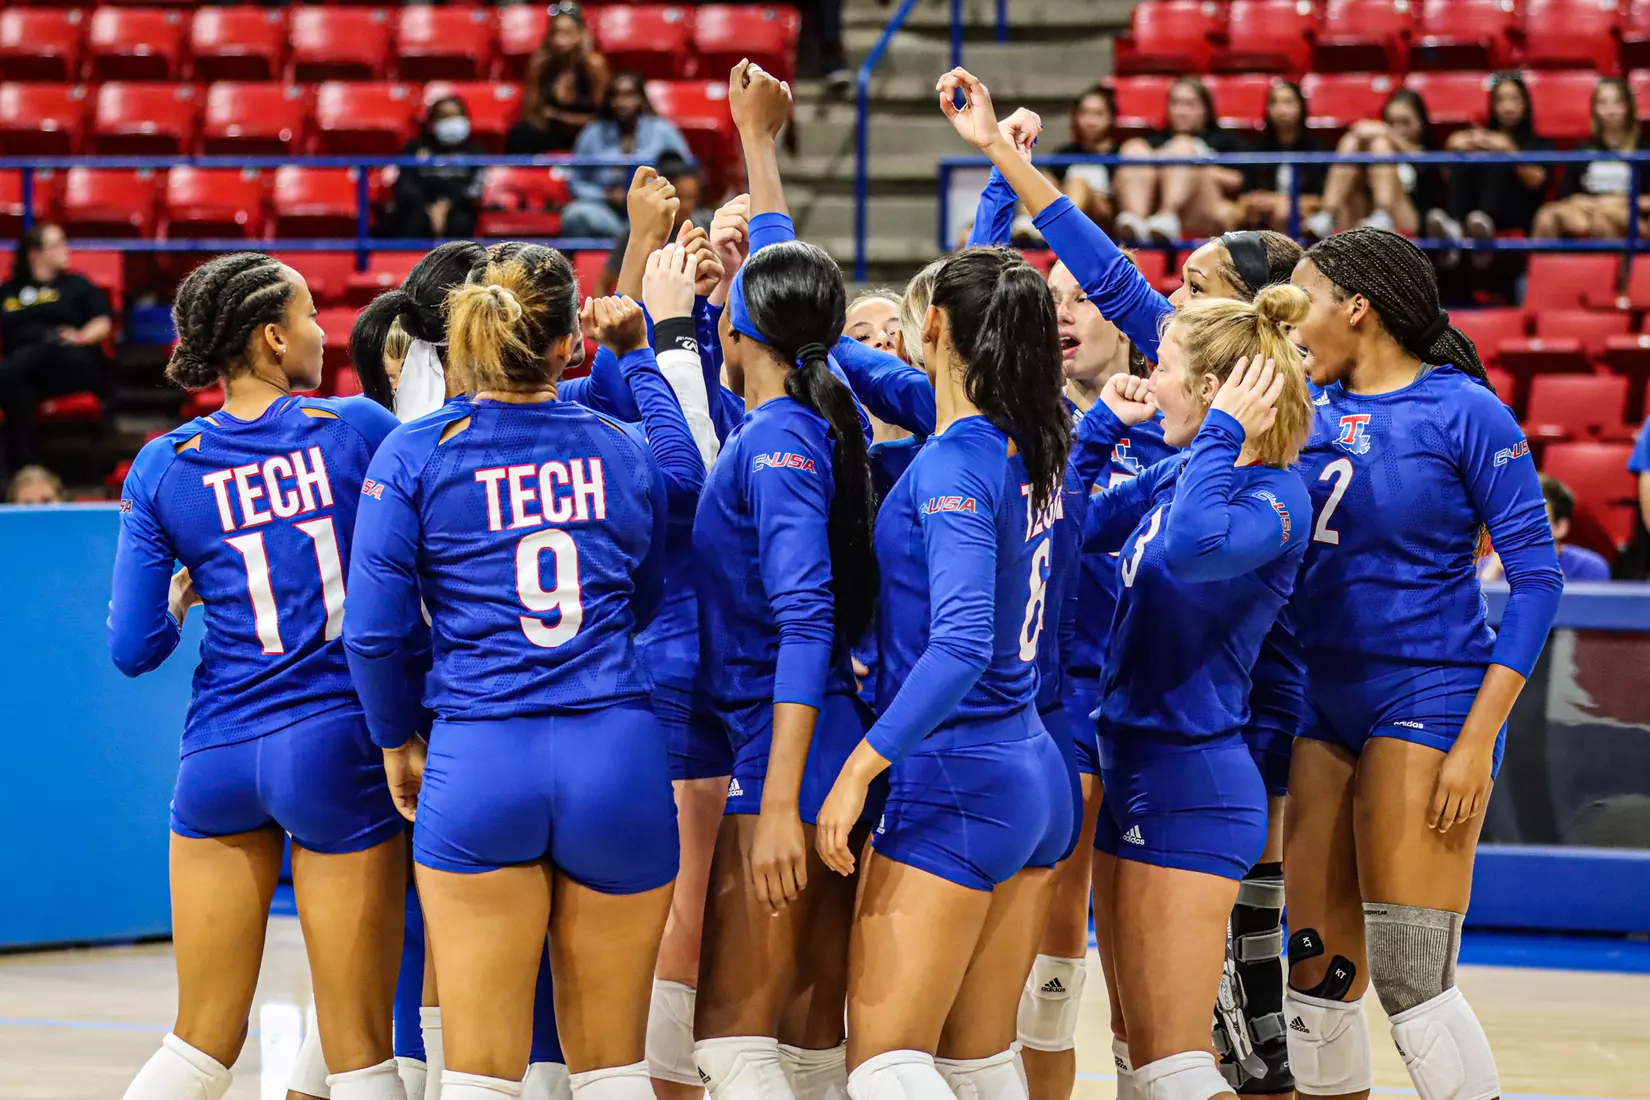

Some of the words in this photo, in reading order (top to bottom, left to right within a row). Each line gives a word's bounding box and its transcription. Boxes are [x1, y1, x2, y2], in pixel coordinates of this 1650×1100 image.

[202, 446, 334, 533] TECH
[474, 457, 606, 532] TECH
[1312, 457, 1354, 545] 2
[223, 515, 345, 655] 11
[514, 528, 584, 649] 9
[1121, 504, 1163, 588] 3
[1018, 537, 1051, 662] 6
[1123, 834, 1145, 846] adidas
[1303, 936, 1313, 948] KT
[1335, 968, 1347, 979] KT
